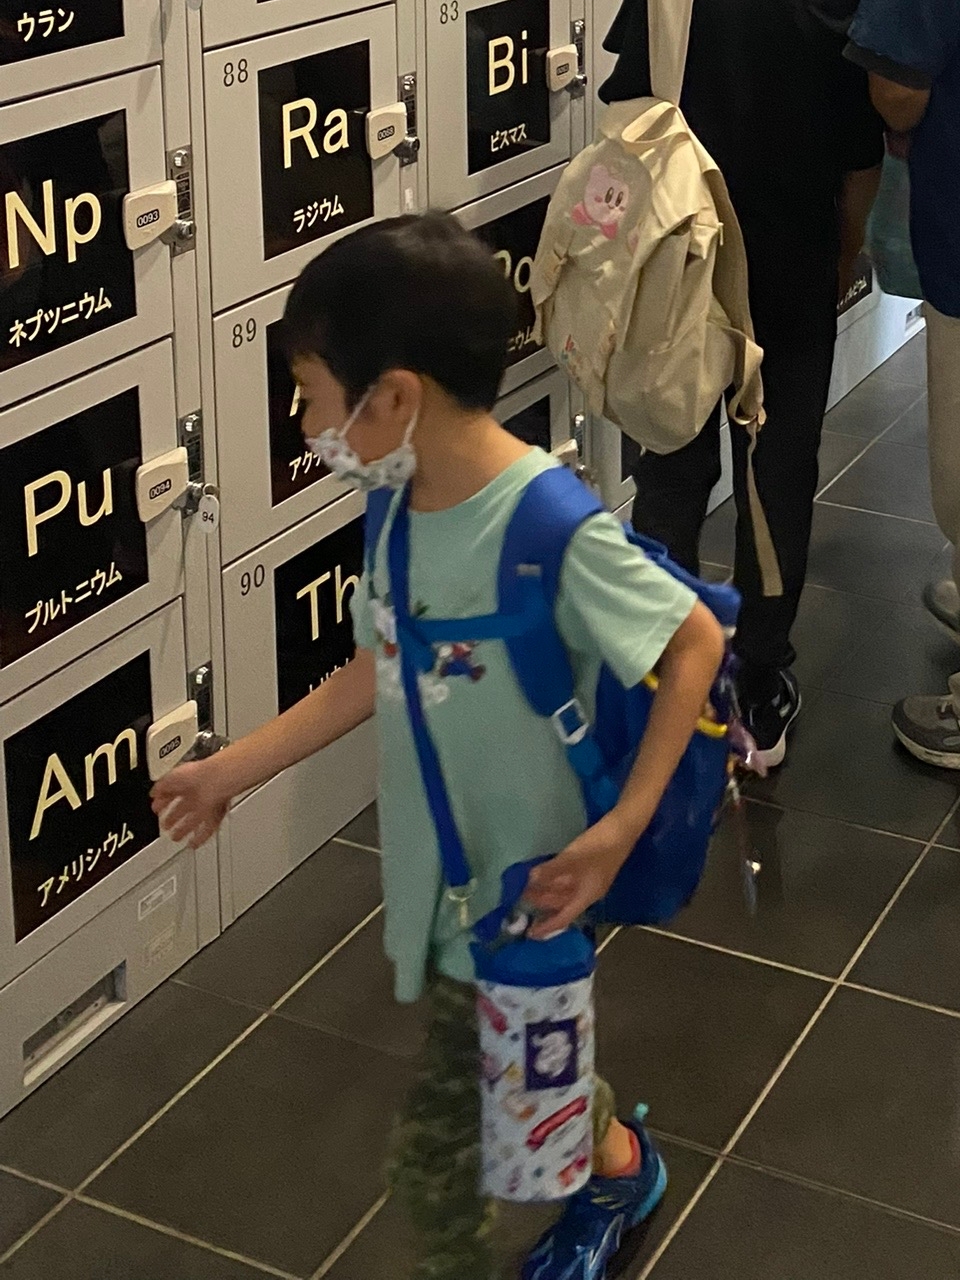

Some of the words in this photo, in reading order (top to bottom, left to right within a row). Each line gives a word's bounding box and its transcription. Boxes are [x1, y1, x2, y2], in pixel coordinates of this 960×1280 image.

[17, 8, 74, 42] ウラン
[440, 0, 459, 24] 83
[223, 58, 248, 87] 88
[488, 30, 528, 96] Bi
[282, 97, 350, 169] Ra
[490, 123, 528, 152] ビスマス
[5, 179, 101, 269] Np
[136, 210, 160, 227] 0093
[293, 195, 344, 233] ラジウム
[9, 287, 112, 347] ネプツニウム
[232, 318, 257, 348] 89
[150, 479, 172, 499] 0094
[24, 468, 113, 558] Pu
[202, 511, 214, 524] 94
[25, 561, 123, 634] プルトニウム
[240, 564, 265, 596] 90
[296, 564, 360, 641] Th
[159, 736, 182, 759] 0095
[29, 727, 138, 841] Am
[37, 822, 134, 908] アメリシウム
